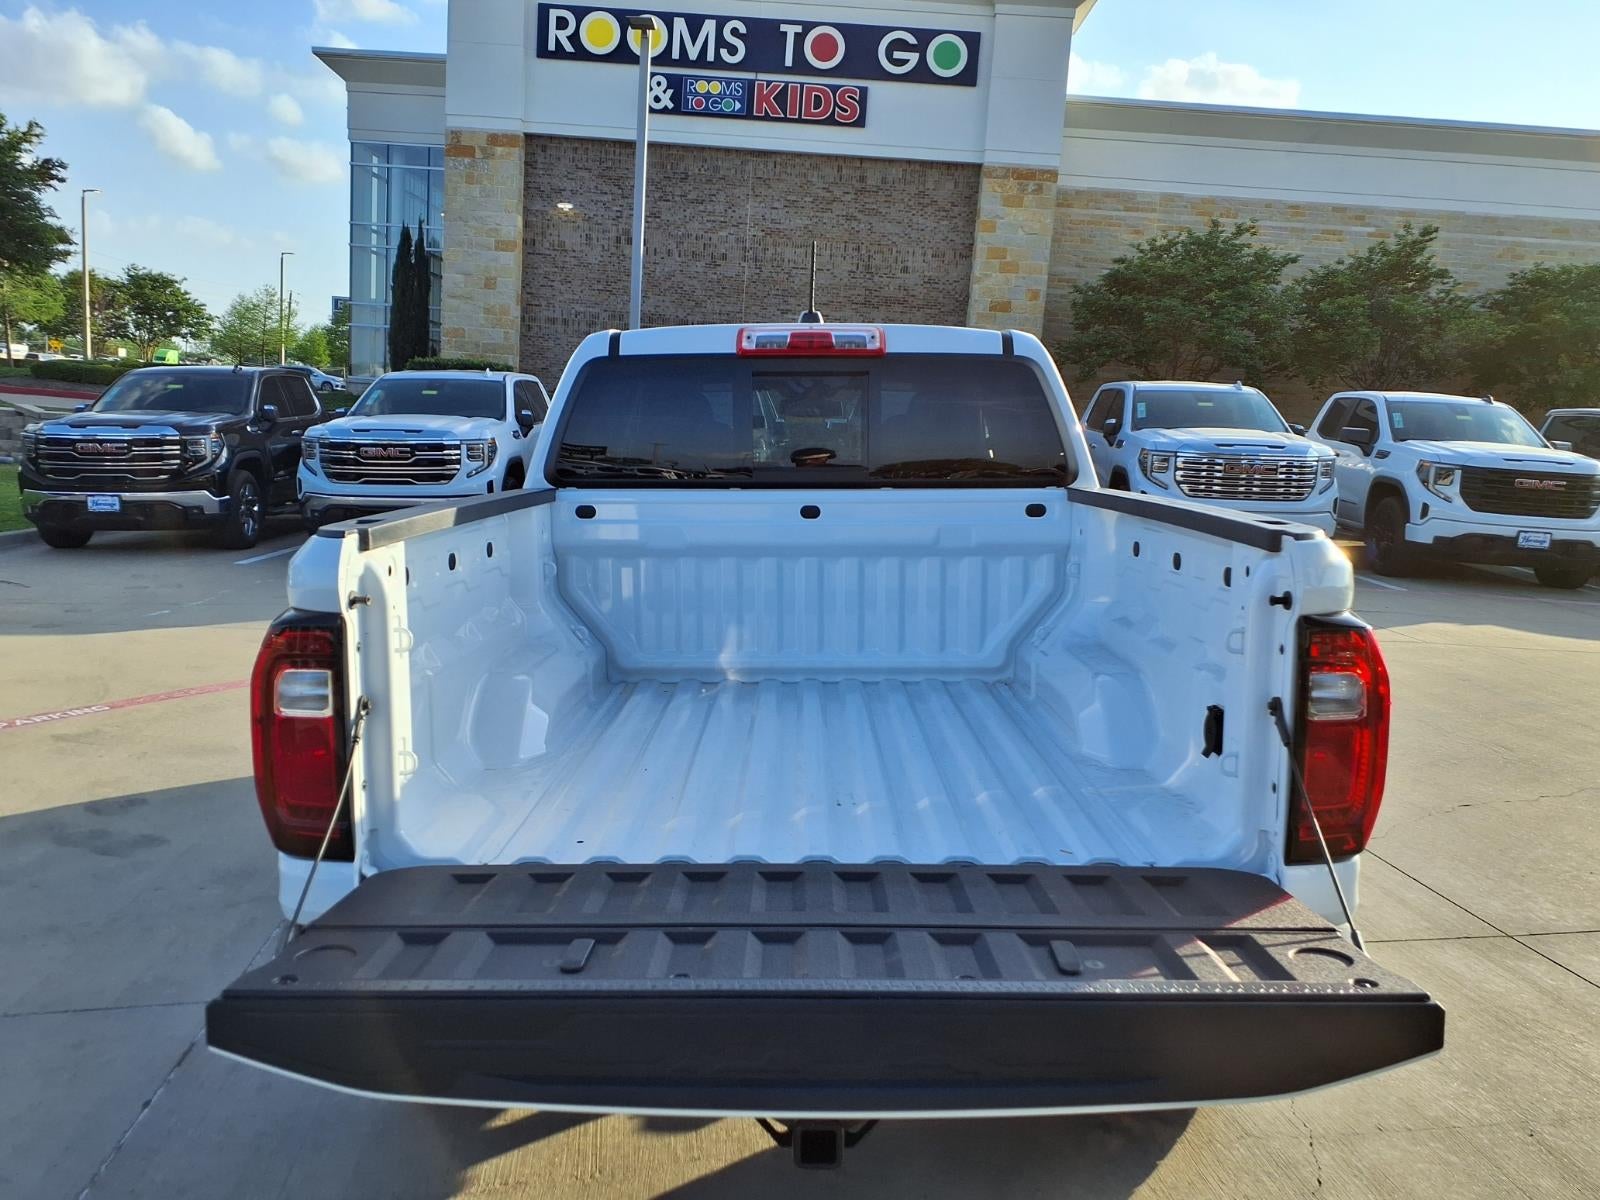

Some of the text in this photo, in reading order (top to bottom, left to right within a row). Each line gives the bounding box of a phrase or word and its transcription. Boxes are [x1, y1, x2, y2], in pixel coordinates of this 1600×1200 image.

[547, 8, 968, 78] ROOMS TO GO
[649, 75, 674, 110] &
[687, 79, 742, 96] ROOMS
[687, 96, 735, 112] TO GO
[753, 81, 860, 123] KIDS
[75, 442, 128, 453] GMC
[360, 447, 411, 457] GMC
[1226, 463, 1277, 475] GMC
[1515, 478, 1567, 491] GMC
